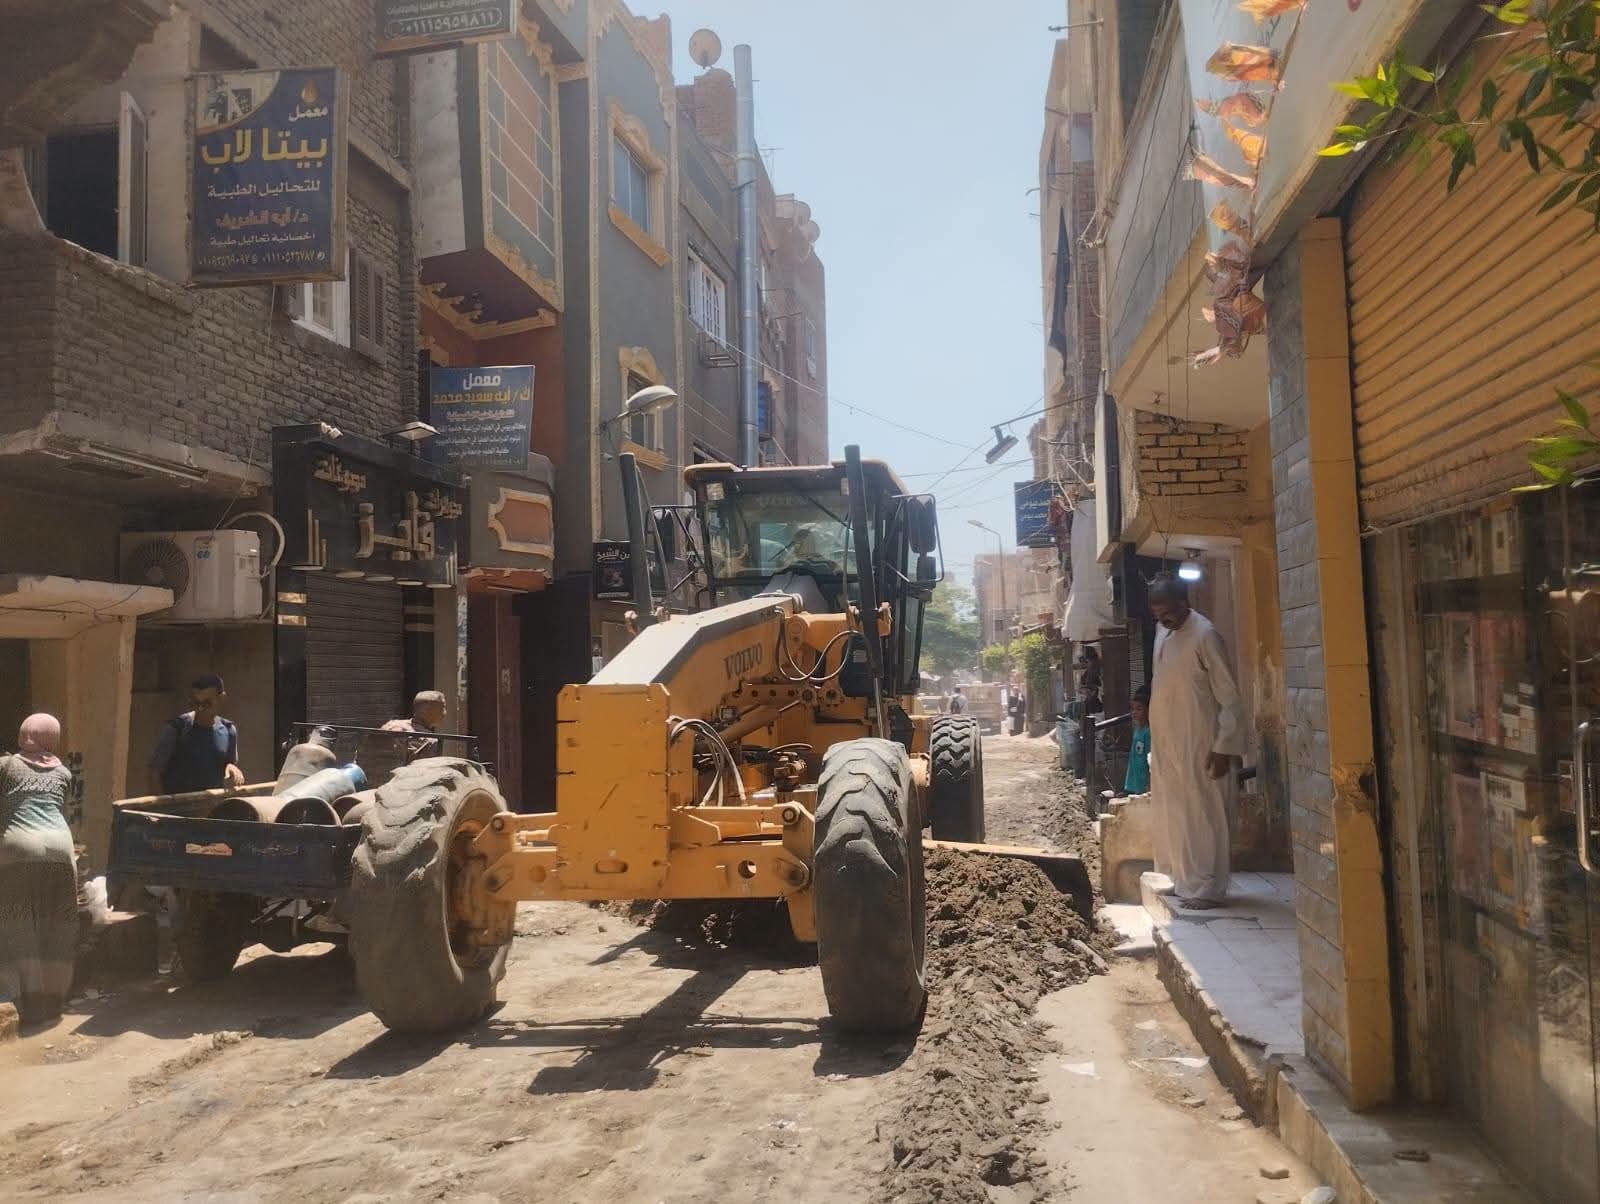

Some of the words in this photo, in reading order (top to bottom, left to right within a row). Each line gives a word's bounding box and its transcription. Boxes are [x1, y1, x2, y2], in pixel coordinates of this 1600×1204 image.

[288, 104, 328, 122] معمل
[201, 129, 252, 174] لاب
[261, 128, 328, 168] بيتا
[207, 182, 257, 199] الطبية
[258, 179, 321, 197] للتحاليل
[209, 233, 238, 247] طبية
[463, 372, 501, 391] معمل
[723, 641, 763, 680] VOLVO
